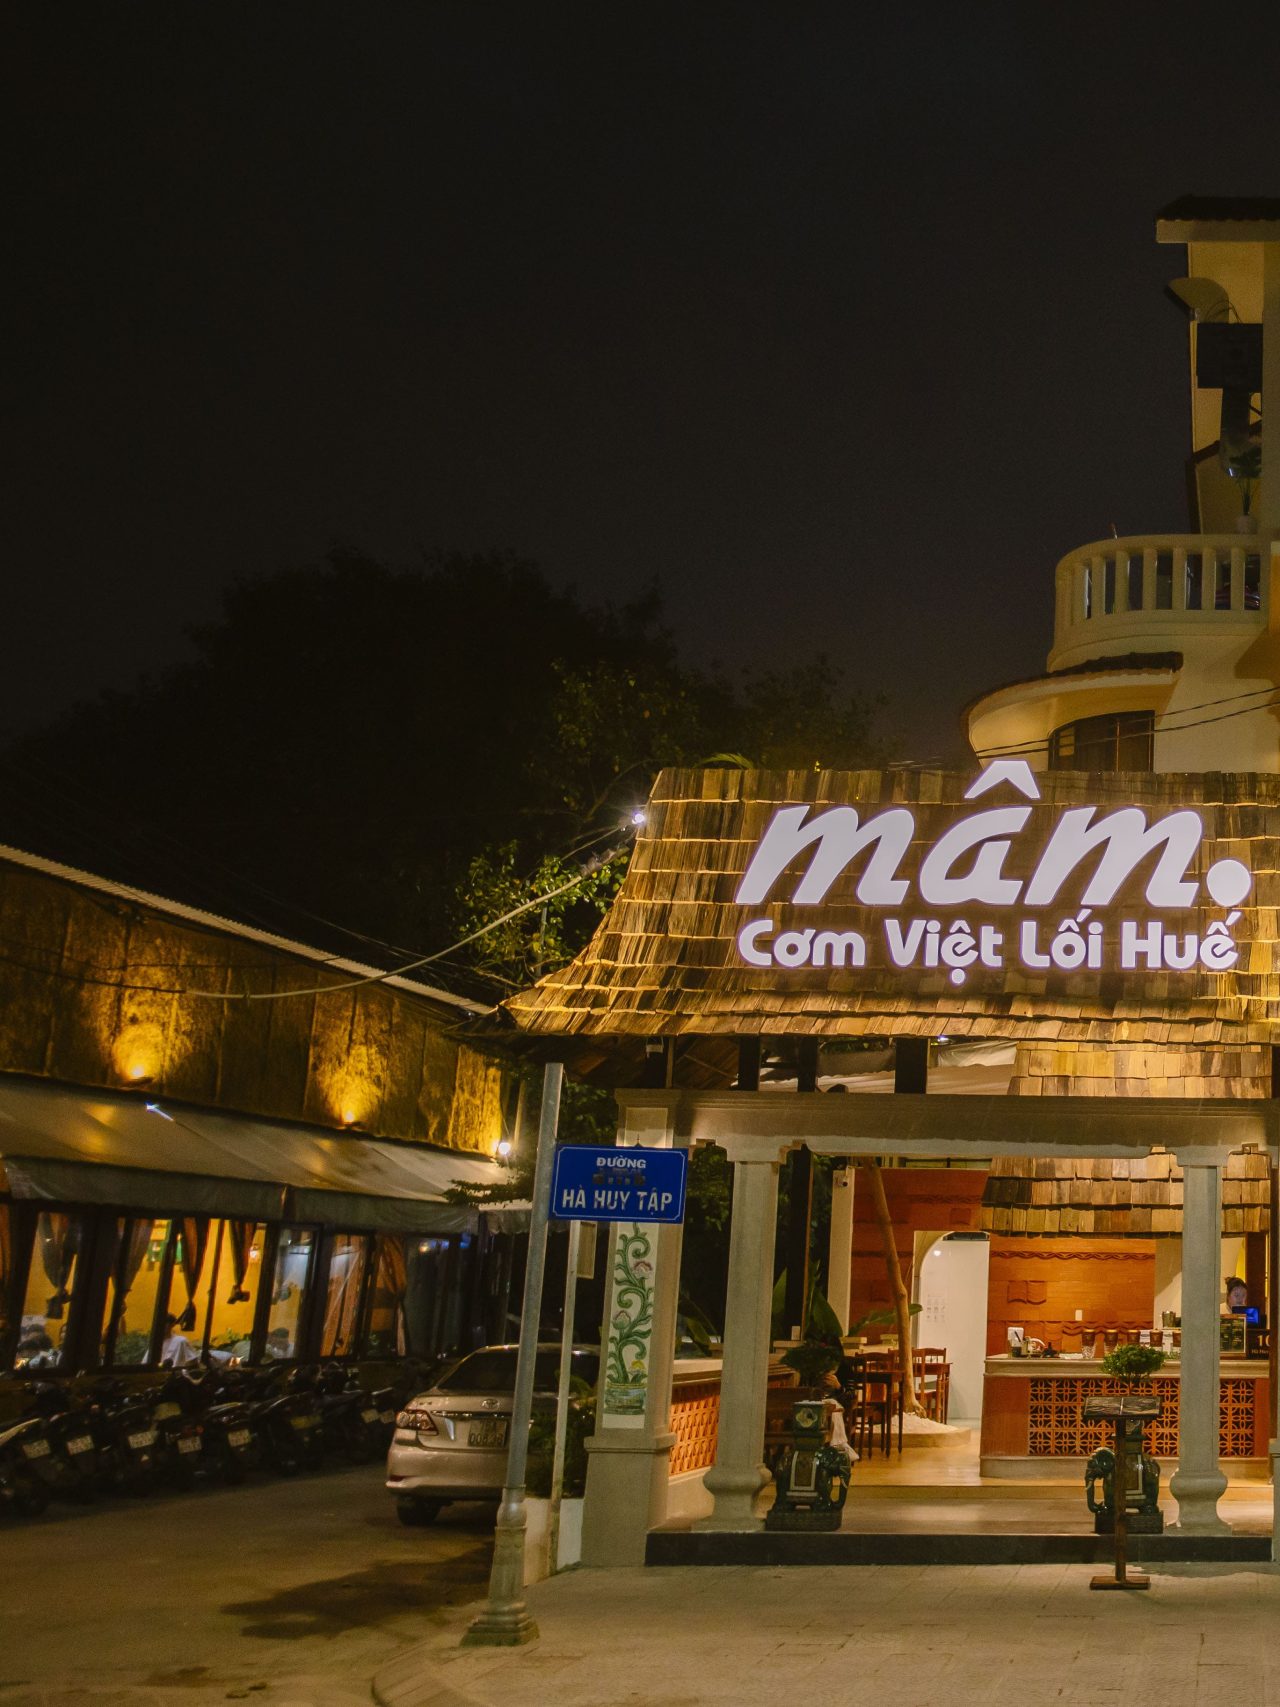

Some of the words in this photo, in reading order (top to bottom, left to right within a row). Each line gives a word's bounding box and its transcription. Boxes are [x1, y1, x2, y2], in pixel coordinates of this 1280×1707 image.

[735, 760, 1252, 908] mâm.
[738, 919, 866, 968] Cơm
[884, 919, 1003, 985] Việt
[1021, 909, 1103, 969] Lối
[1121, 911, 1241, 970] Huế
[596, 1155, 647, 1169] ĐƯỜNG
[562, 1185, 586, 1209] HÀ
[593, 1190, 631, 1210] HUY
[637, 1187, 673, 1216] TẬP
